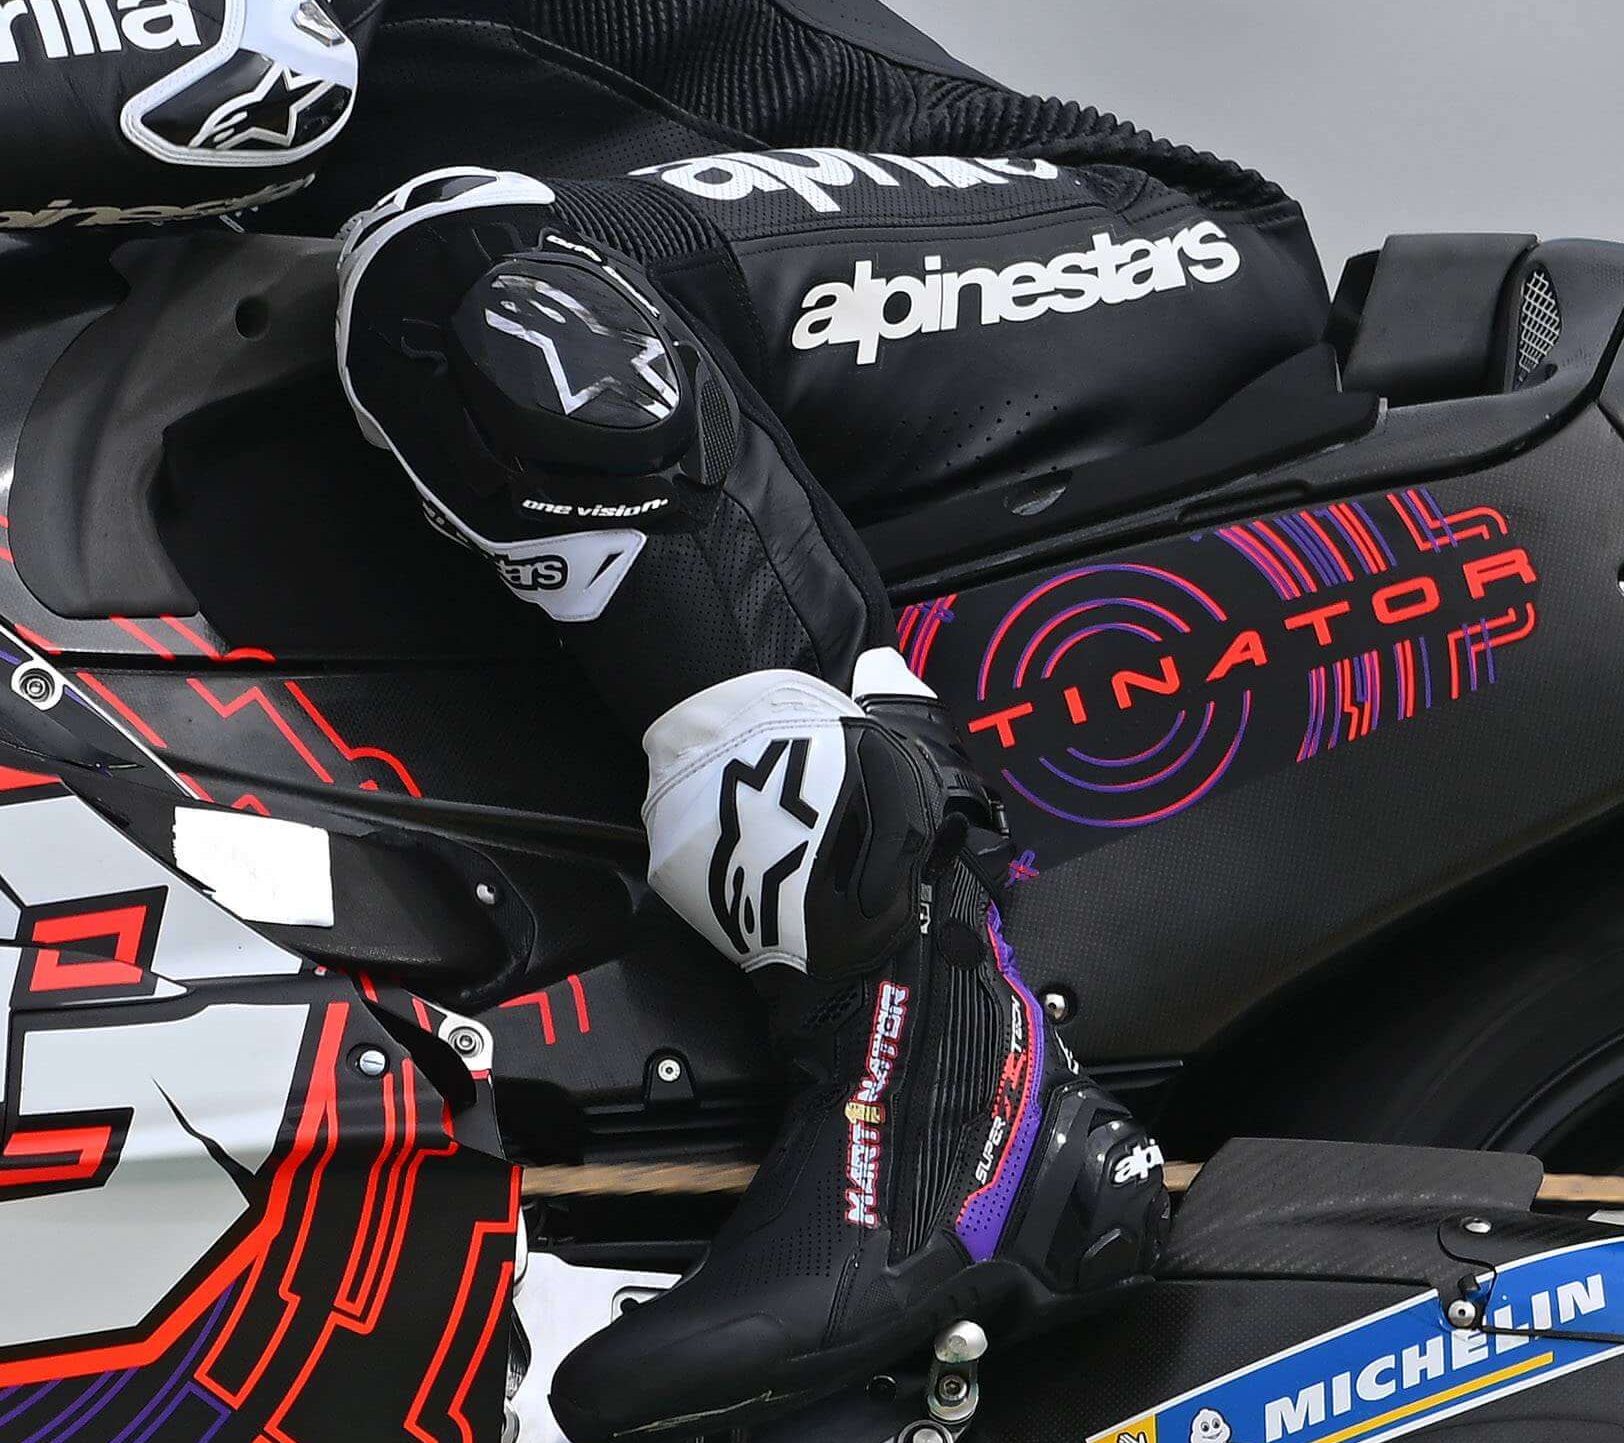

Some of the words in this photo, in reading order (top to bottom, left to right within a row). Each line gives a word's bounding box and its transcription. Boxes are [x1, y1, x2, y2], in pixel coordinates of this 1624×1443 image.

[791, 220, 1241, 365] alpinestars
[522, 499, 571, 515] one
[577, 498, 662, 517] vision
[968, 547, 1538, 748] TINATOR
[975, 1115, 1007, 1185] SUPER
[1264, 1273, 1607, 1443] MICHELIN
